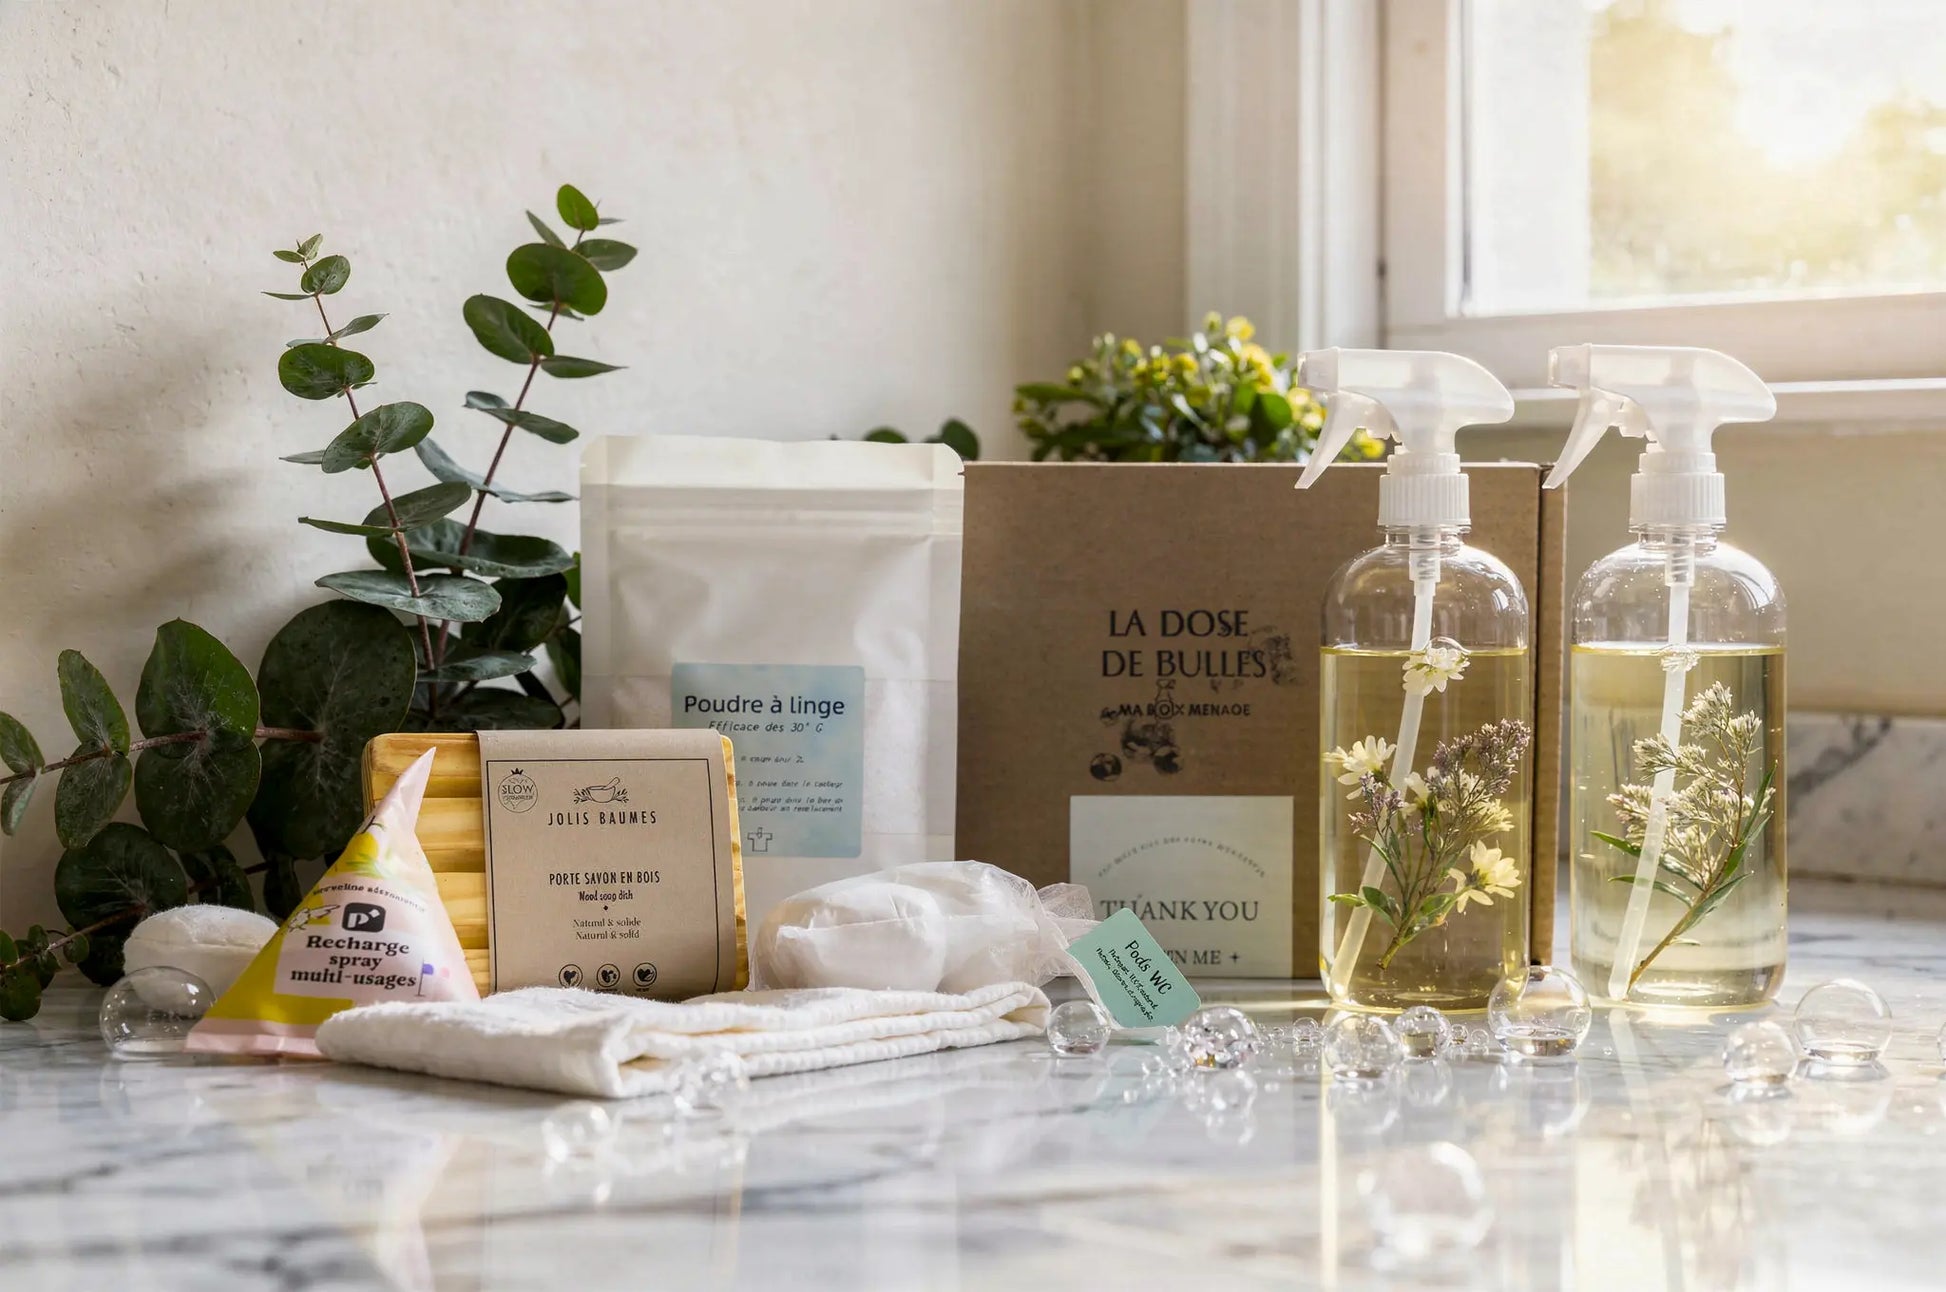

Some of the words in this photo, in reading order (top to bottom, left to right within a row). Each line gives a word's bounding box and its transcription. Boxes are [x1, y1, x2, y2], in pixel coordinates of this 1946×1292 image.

[1110, 609, 1147, 637] LA
[1160, 610, 1249, 637] DOSE
[1102, 650, 1144, 678] DE
[1156, 650, 1267, 678] BULLES
[684, 695, 763, 713] Poudre
[770, 695, 783, 713] à
[790, 695, 845, 719] linge
[502, 784, 534, 794] SLOW
[548, 812, 589, 826] JOLIS
[599, 810, 657, 825] BAUMES
[549, 872, 581, 886] PORTE
[584, 871, 617, 885] SAVON
[620, 871, 633, 884] EN
[636, 870, 661, 884] BOIS
[1203, 900, 1259, 921] YOU
[306, 935, 410, 957] Recharge
[329, 955, 382, 971] spray
[1124, 939, 1152, 973] Pods
[1149, 969, 1173, 995] WC
[1193, 950, 1221, 965] ME
[291, 968, 417, 990] multi-usages
